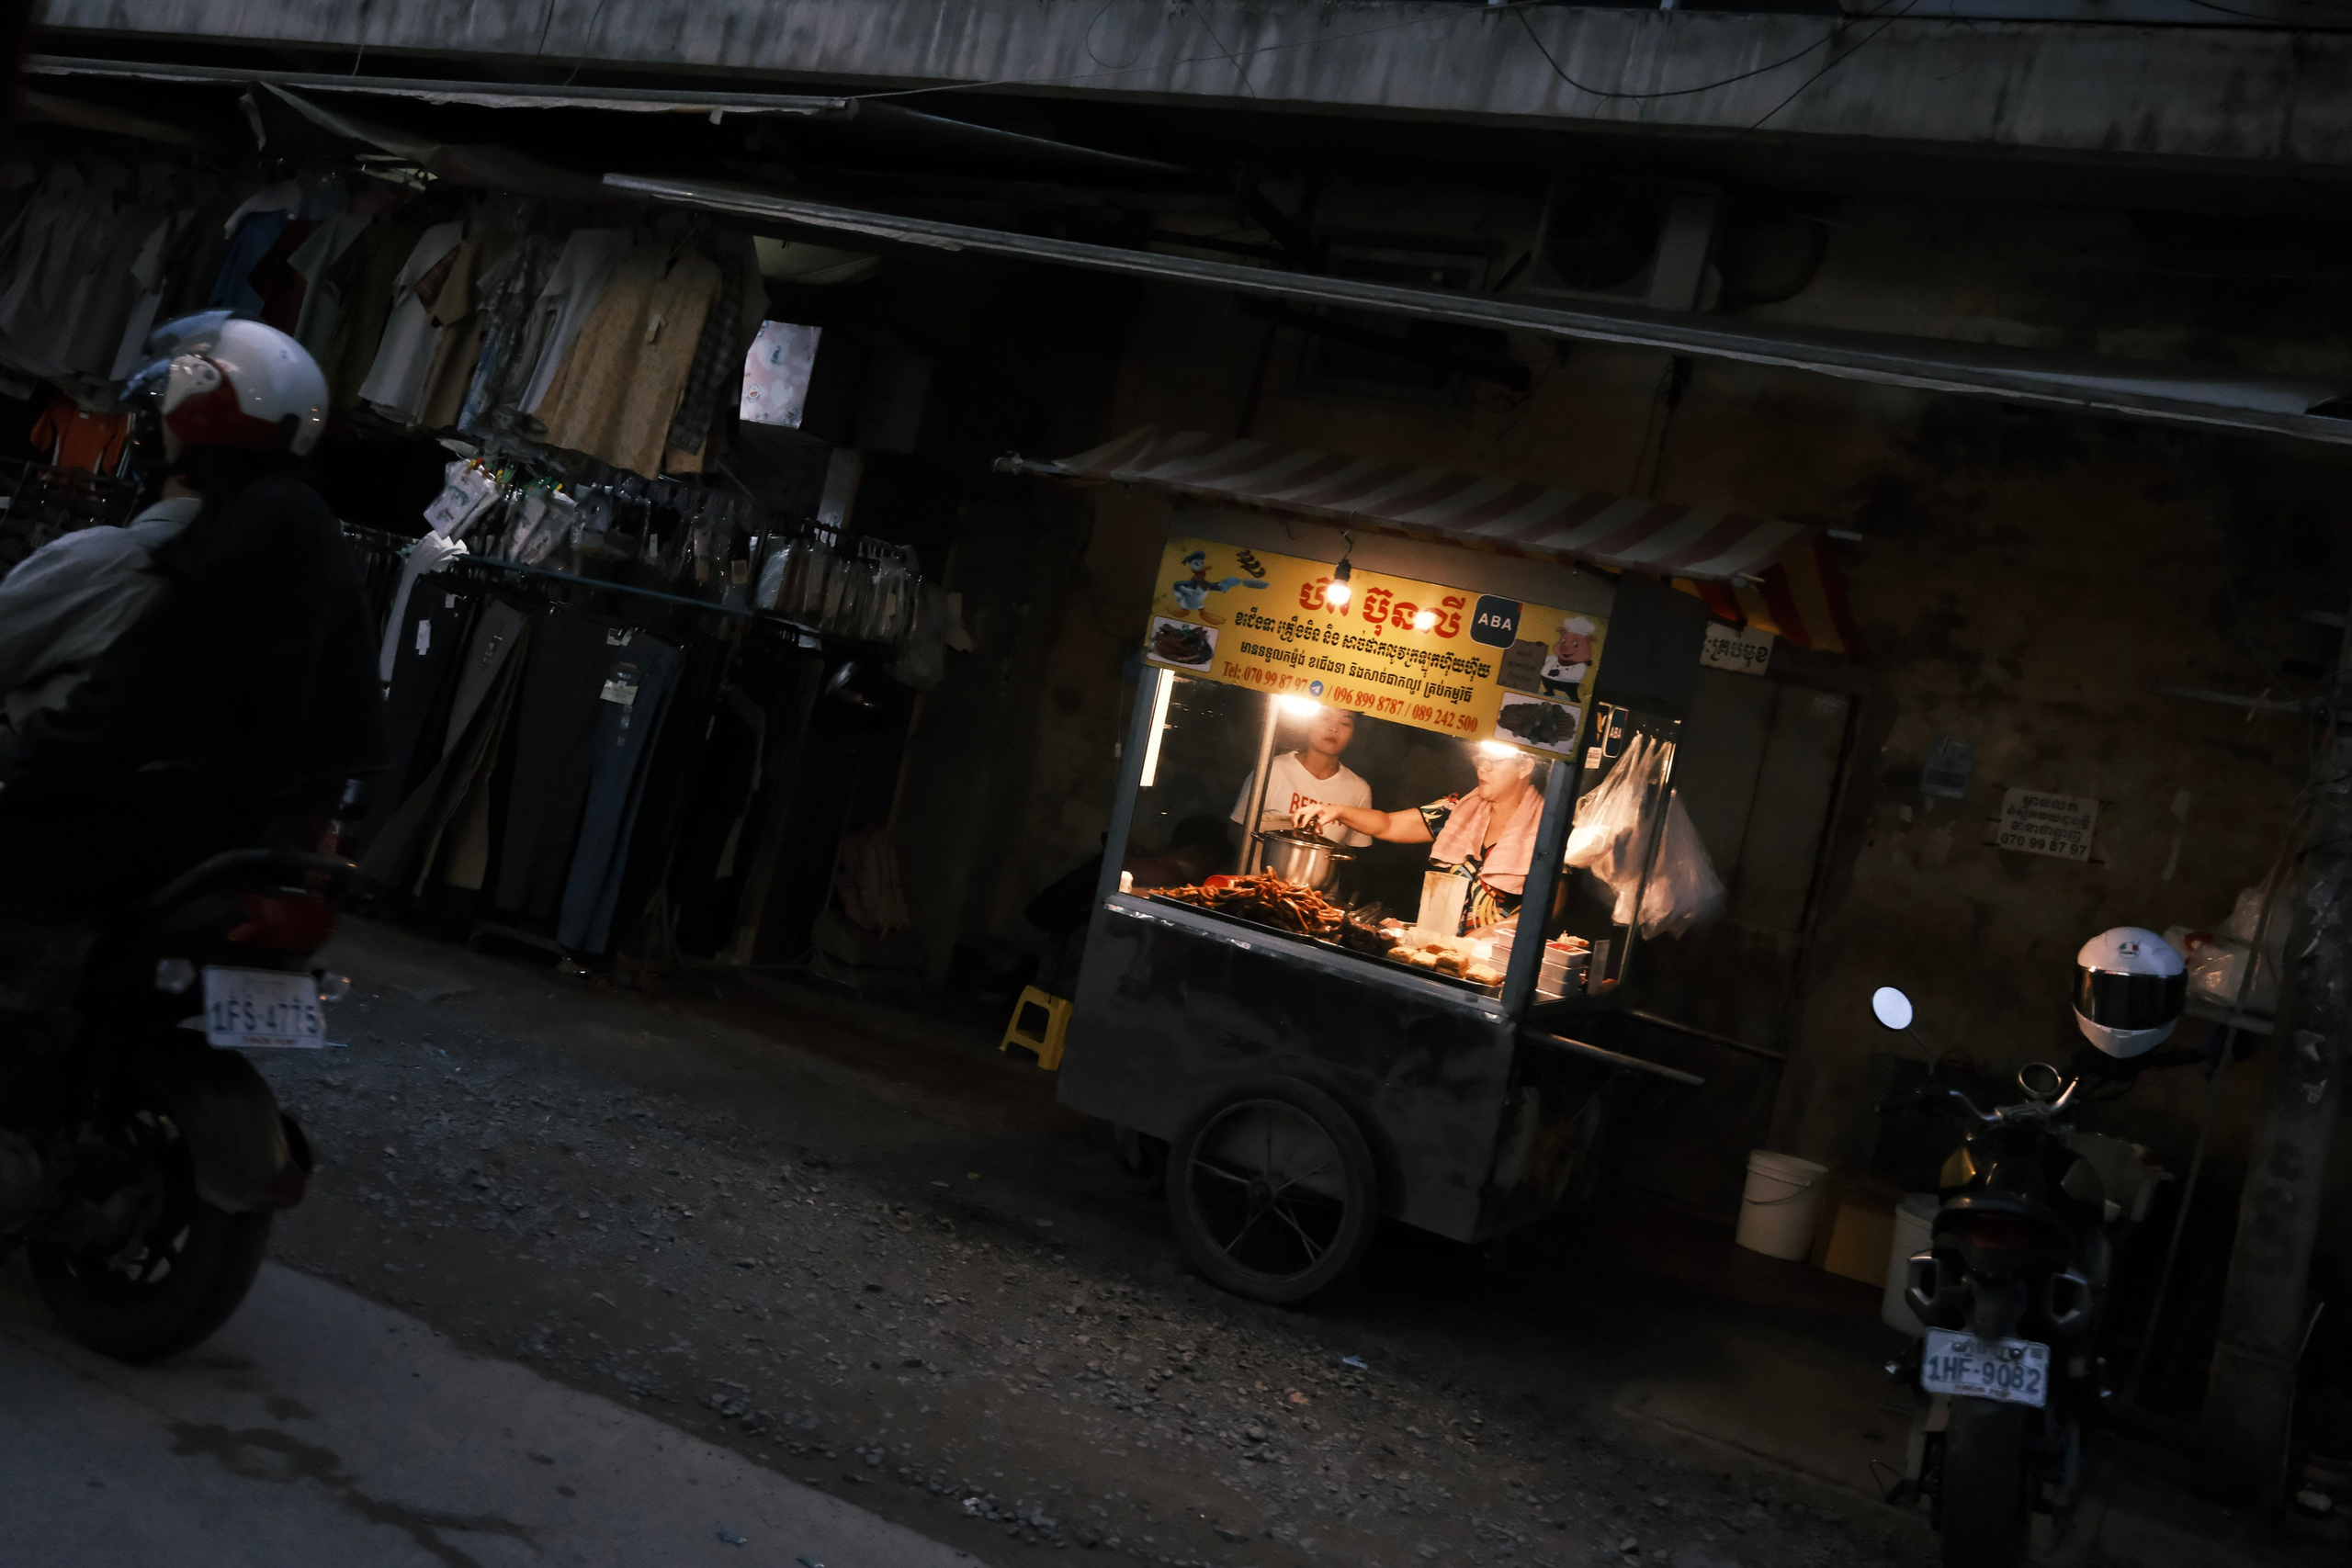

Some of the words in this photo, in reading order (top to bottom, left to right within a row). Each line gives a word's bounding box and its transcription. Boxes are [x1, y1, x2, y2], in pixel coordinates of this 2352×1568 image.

[1478, 613, 1511, 631] ABA
[1323, 624, 1340, 646] និង
[1223, 661, 1240, 680] Tel:
[1243, 666, 1262, 683] 070
[1265, 671, 1277, 687] 99
[1279, 673, 1293, 689] 87
[1295, 677, 1308, 693] 97
[1334, 686, 1354, 705] 096
[1355, 691, 1375, 708] 899
[1376, 696, 1405, 716] 8787
[1412, 704, 1433, 721] 089
[1434, 709, 1455, 728] 242
[1456, 715, 1478, 732] 500
[2001, 833, 2025, 846] 070
[2030, 837, 2045, 850] 99
[2050, 840, 2066, 852] 87
[2070, 844, 2087, 856] 97
[1928, 1355, 2041, 1394] 1HF-9082
